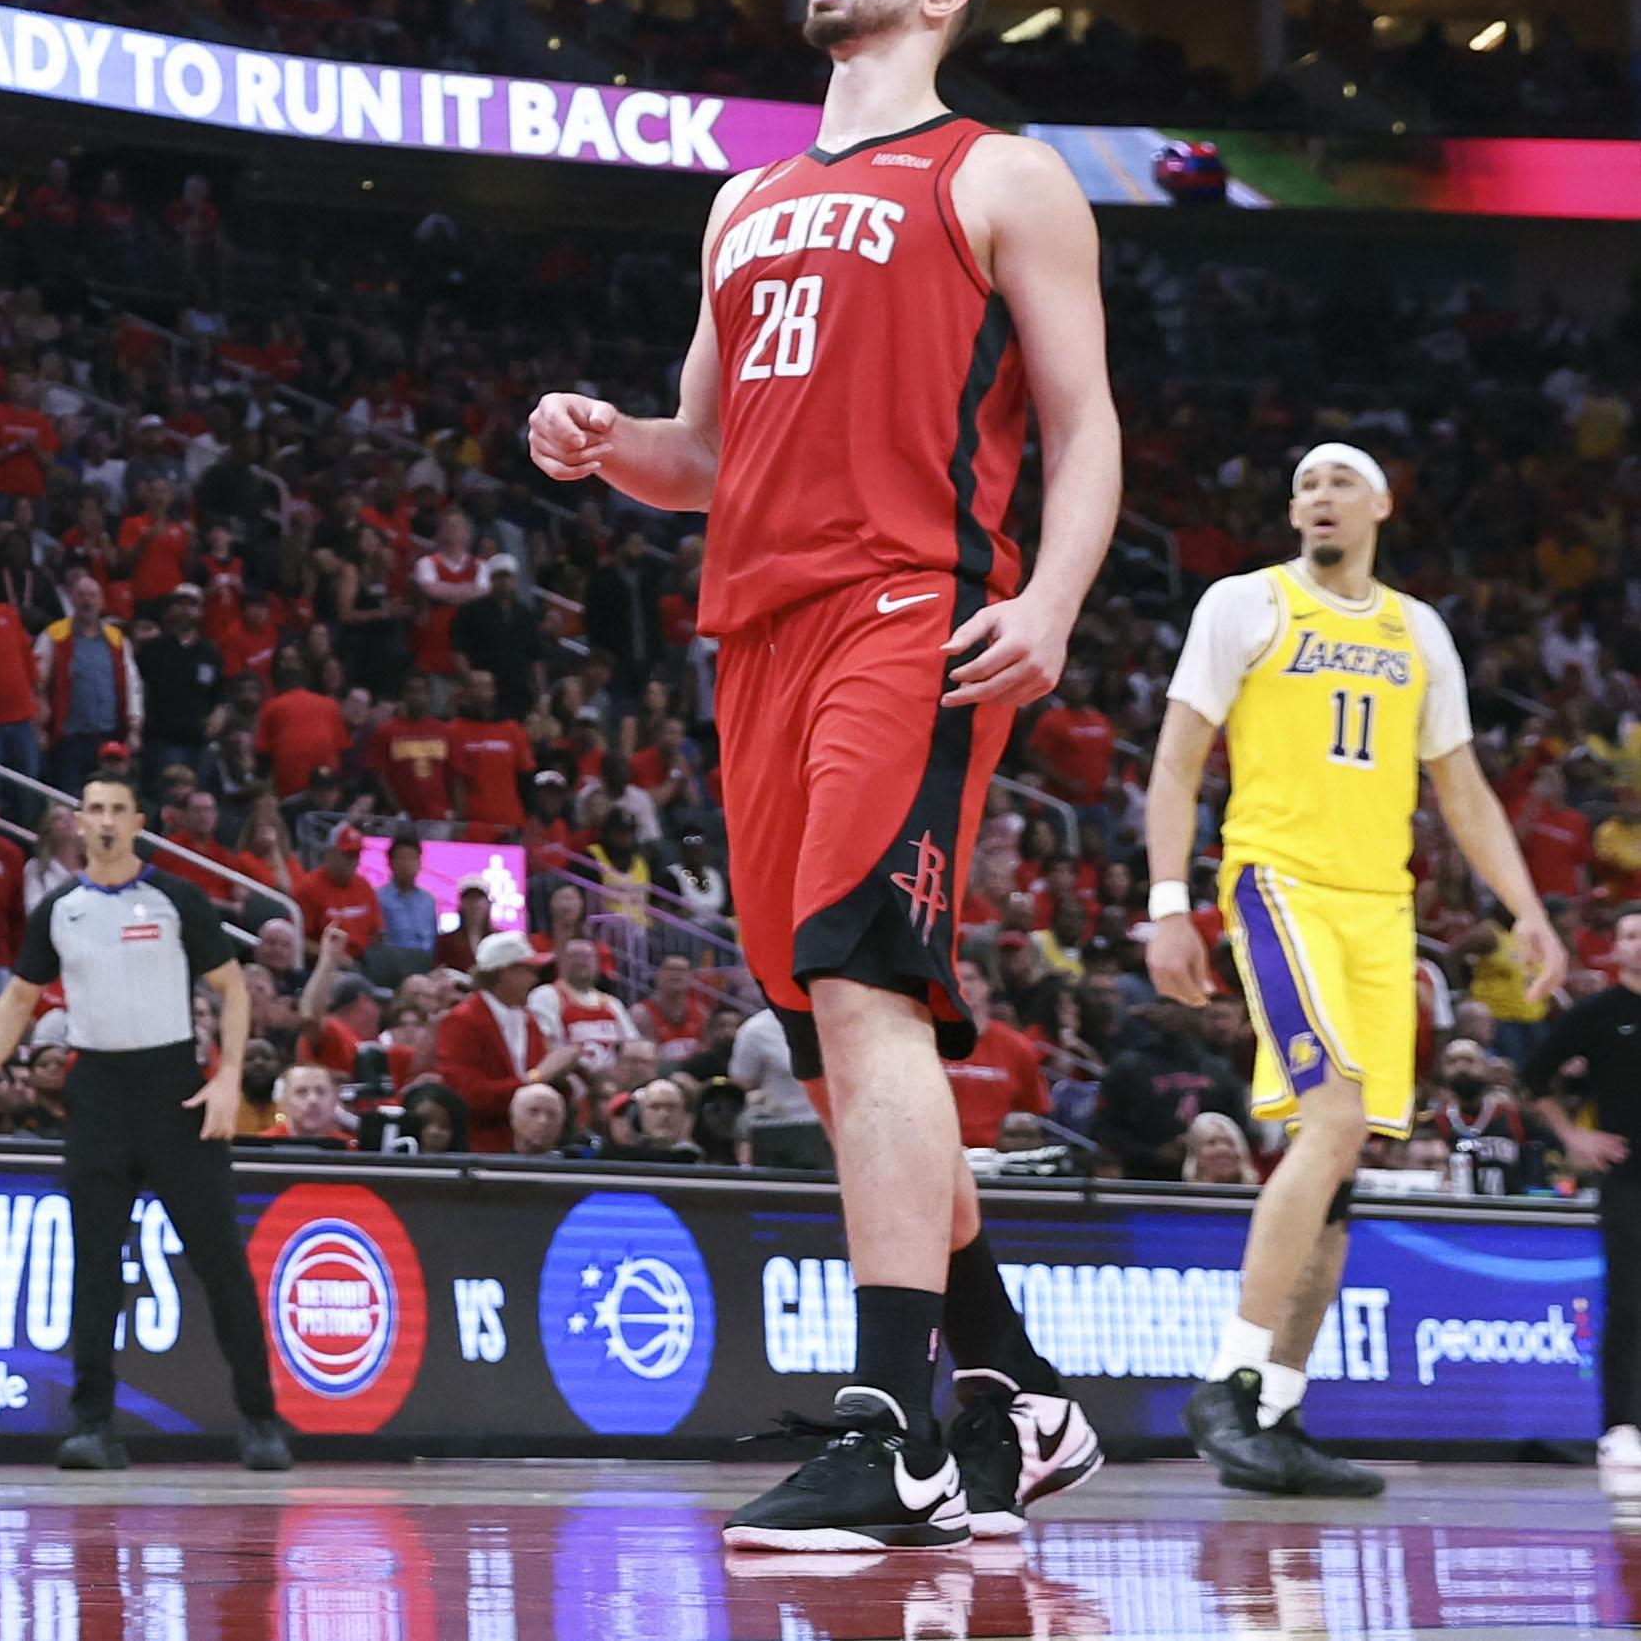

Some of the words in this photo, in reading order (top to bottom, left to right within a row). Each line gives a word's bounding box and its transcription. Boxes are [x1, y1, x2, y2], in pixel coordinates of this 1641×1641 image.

[120, 30, 223, 119] TO
[235, 51, 415, 145] RUN
[418, 72, 495, 150] IT
[507, 78, 730, 172] BACK
[714, 191, 907, 294] ROCKETS
[739, 274, 823, 382] 28
[1280, 630, 1413, 687] LAKERS
[1327, 688, 1376, 768] 11
[453, 1277, 507, 1364] VS
[762, 1255, 858, 1374] GAM
[1415, 1304, 1582, 1385] peacock
